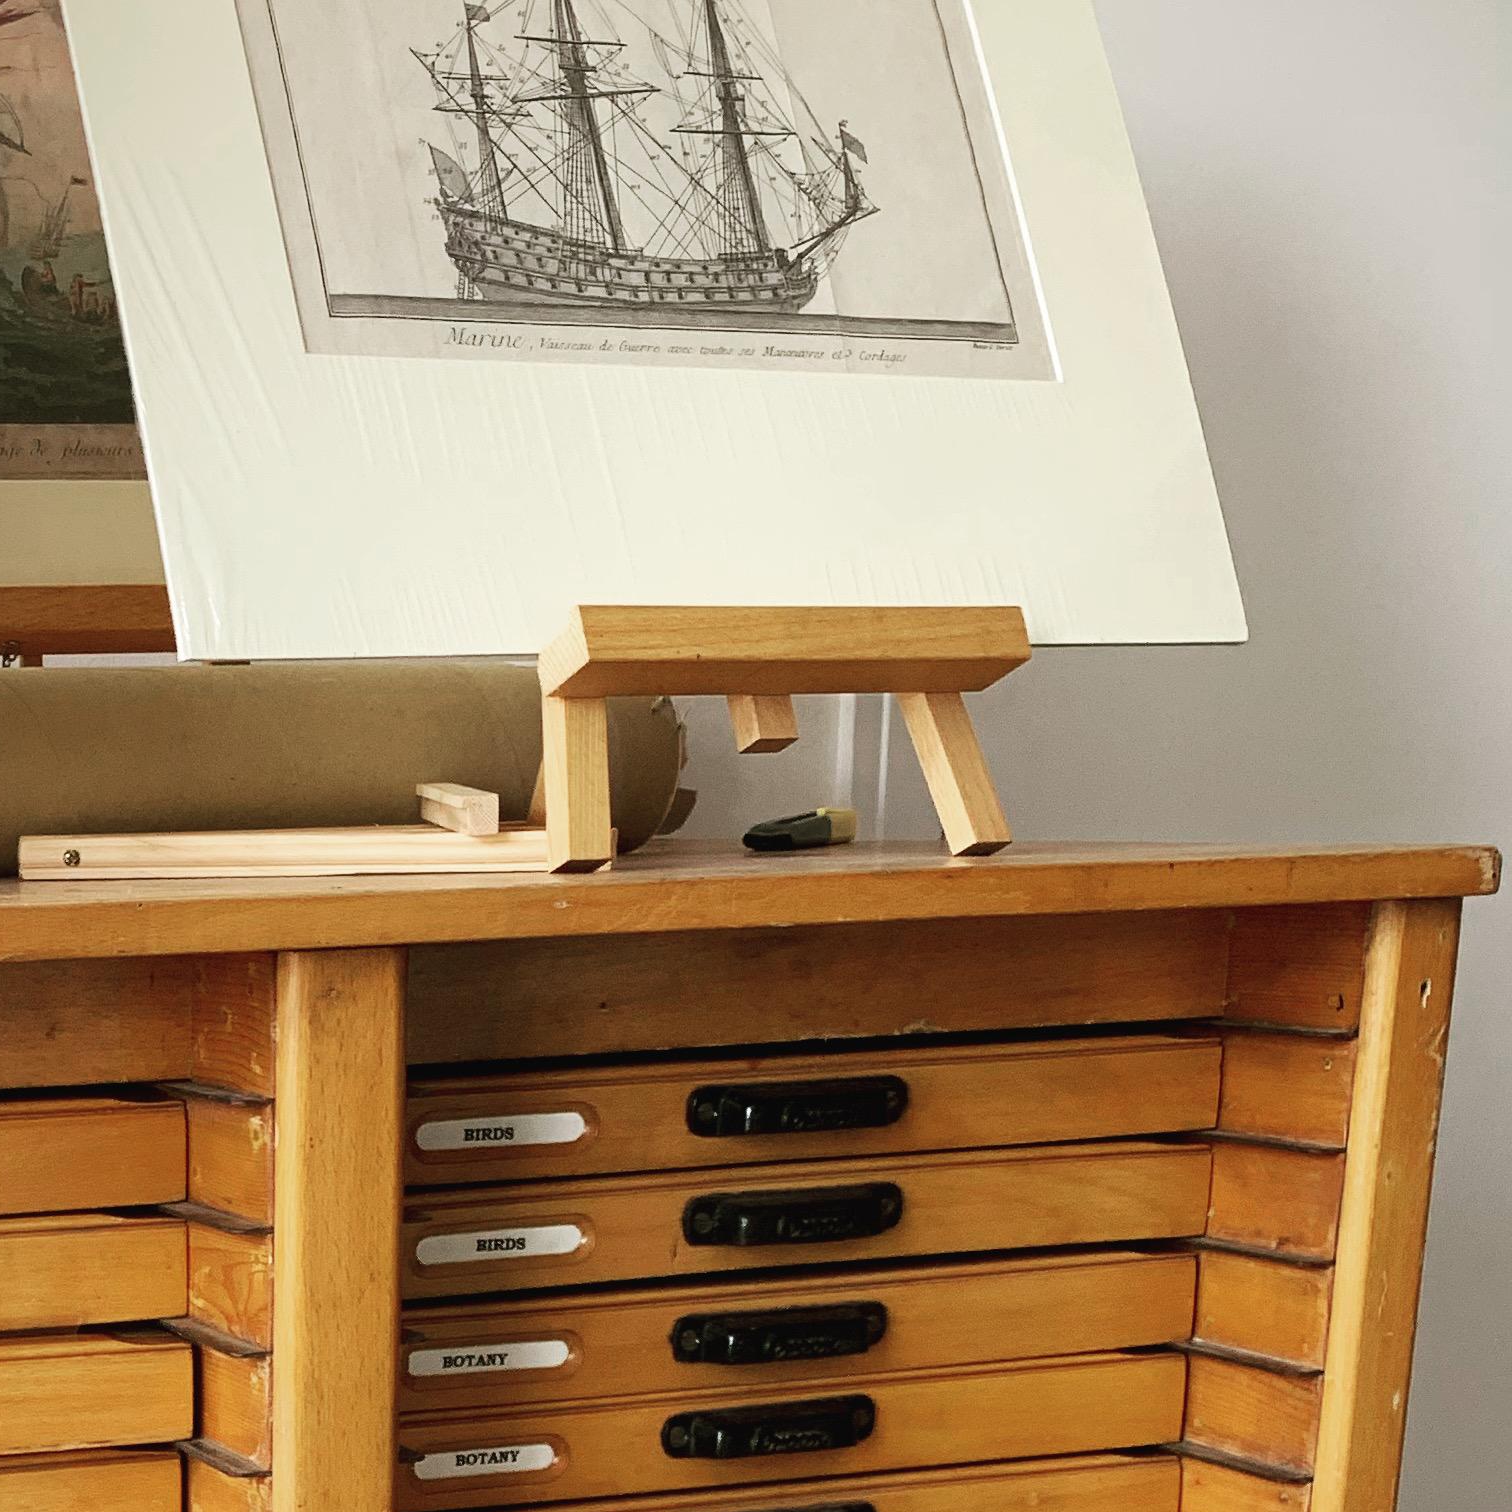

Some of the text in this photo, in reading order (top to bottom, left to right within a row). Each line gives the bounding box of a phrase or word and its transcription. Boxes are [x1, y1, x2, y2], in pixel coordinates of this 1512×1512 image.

[464, 1126, 515, 1142] BIRDS
[475, 1237, 527, 1252] BIRDS
[442, 1353, 508, 1369] BOTANY
[455, 1450, 520, 1467] BOTANY
